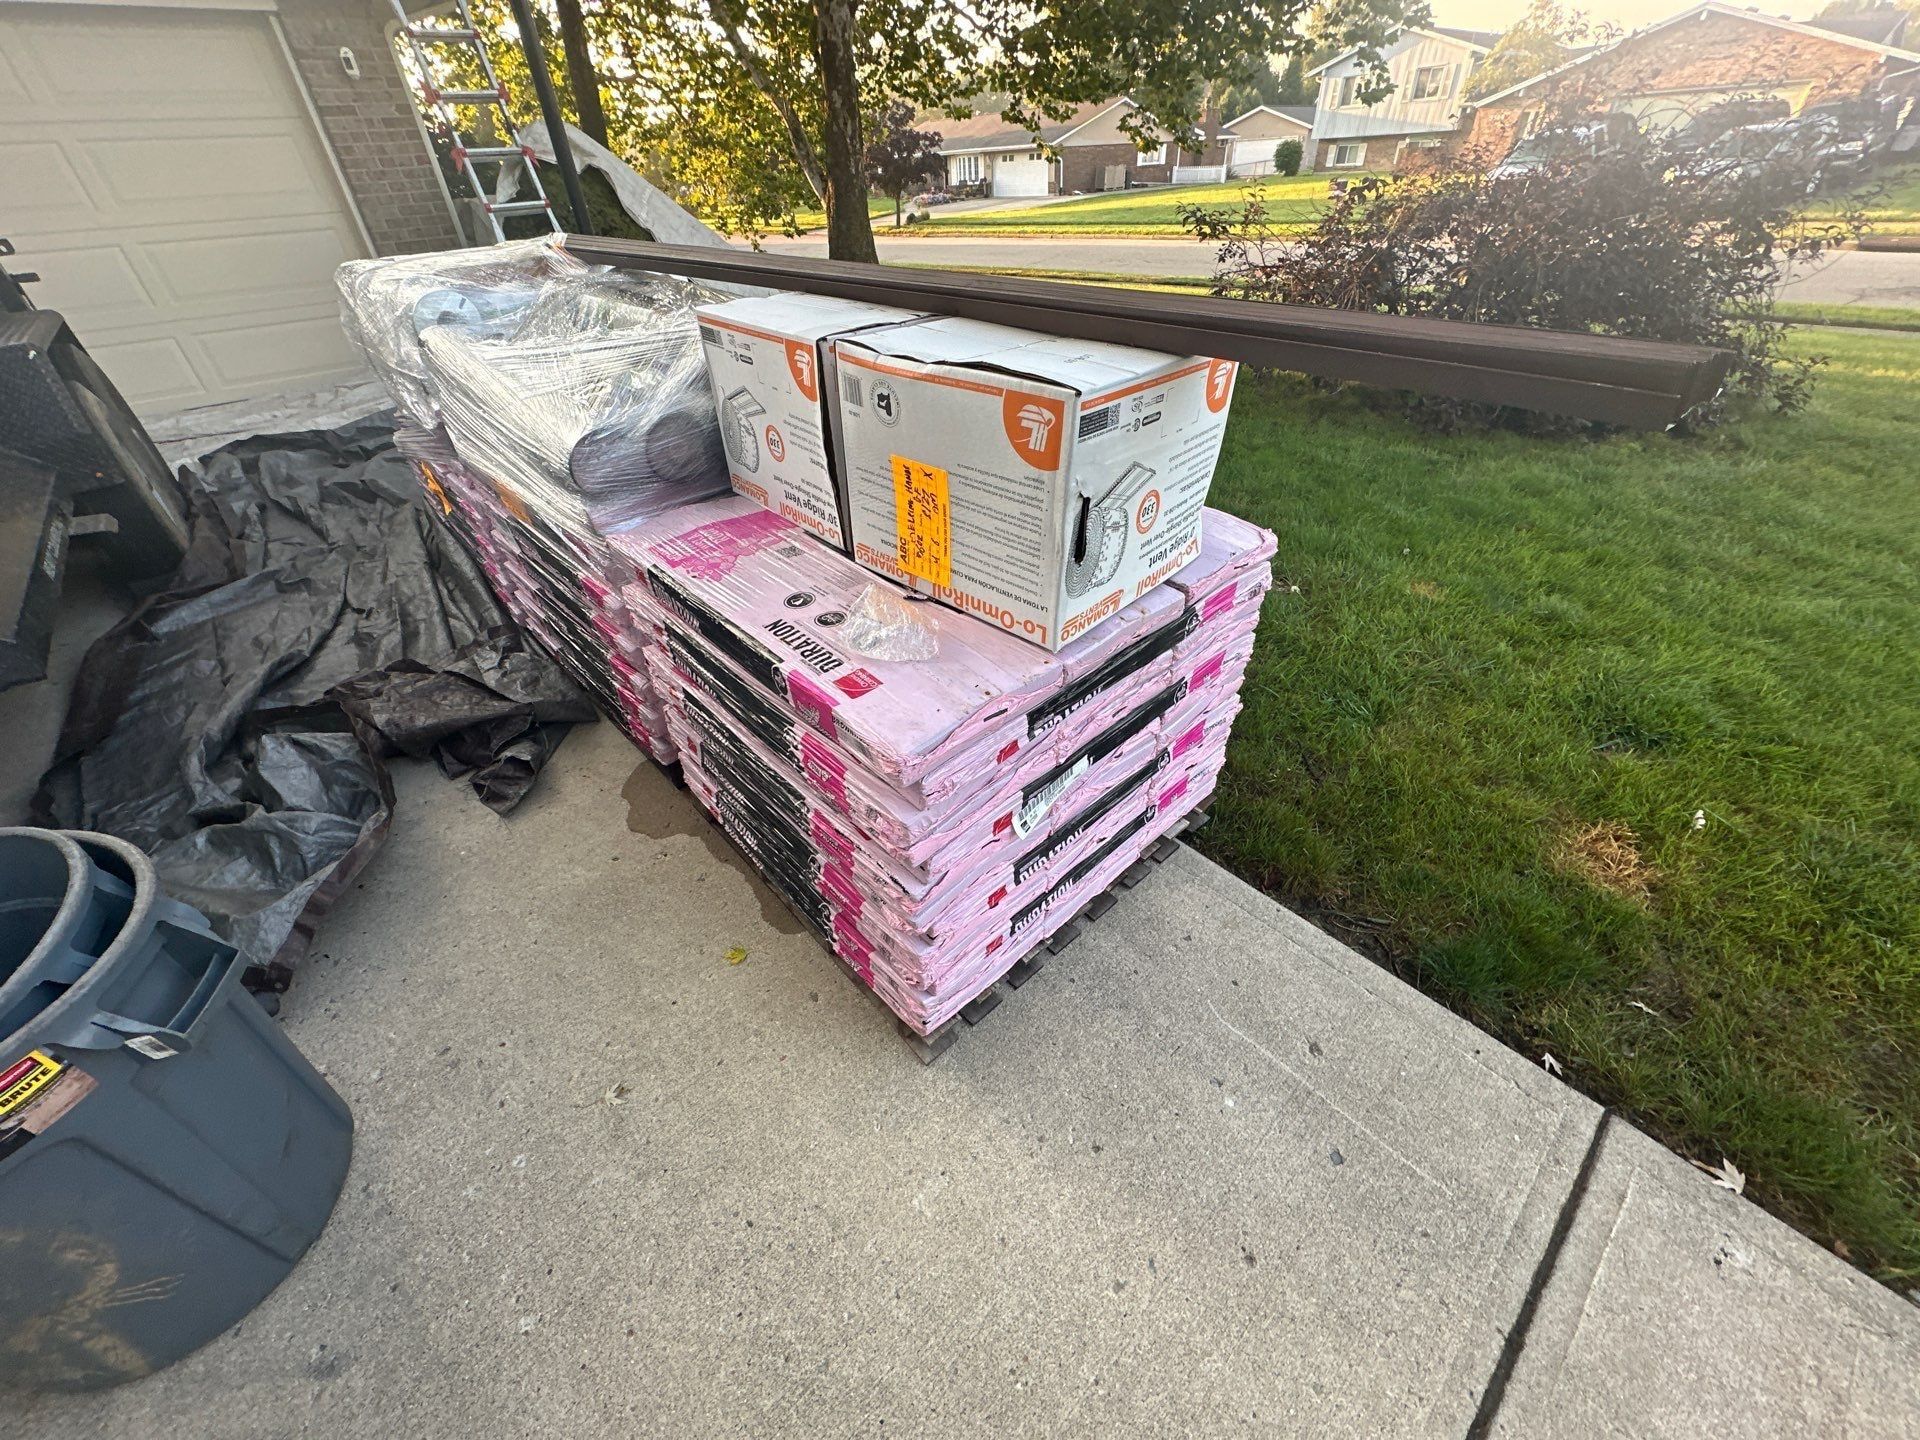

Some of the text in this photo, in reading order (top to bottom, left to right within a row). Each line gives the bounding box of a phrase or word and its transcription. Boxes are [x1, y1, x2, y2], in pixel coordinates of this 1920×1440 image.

[783, 489, 801, 507] Vent
[801, 496, 826, 521] Ridge
[1140, 499, 1156, 518] 330
[778, 500, 840, 543] Lo-OmniRoll
[899, 536, 907, 563] ABC
[1168, 529, 1188, 554] Ridge
[855, 548, 918, 590] LOMANCO
[1134, 536, 1200, 598] Lo-OmniRoll
[1147, 546, 1168, 569] Vent
[963, 572, 977, 584] PARA
[977, 578, 1013, 600] VENTILACIÓN
[1013, 593, 1021, 602] DE
[1021, 596, 1040, 609] TOMA
[932, 578, 1047, 644] Lo-OmniRoll
[1061, 601, 1120, 642] LOMANCO
[763, 619, 845, 674] DURATION
[0, 1066, 51, 1108] BRUTE
